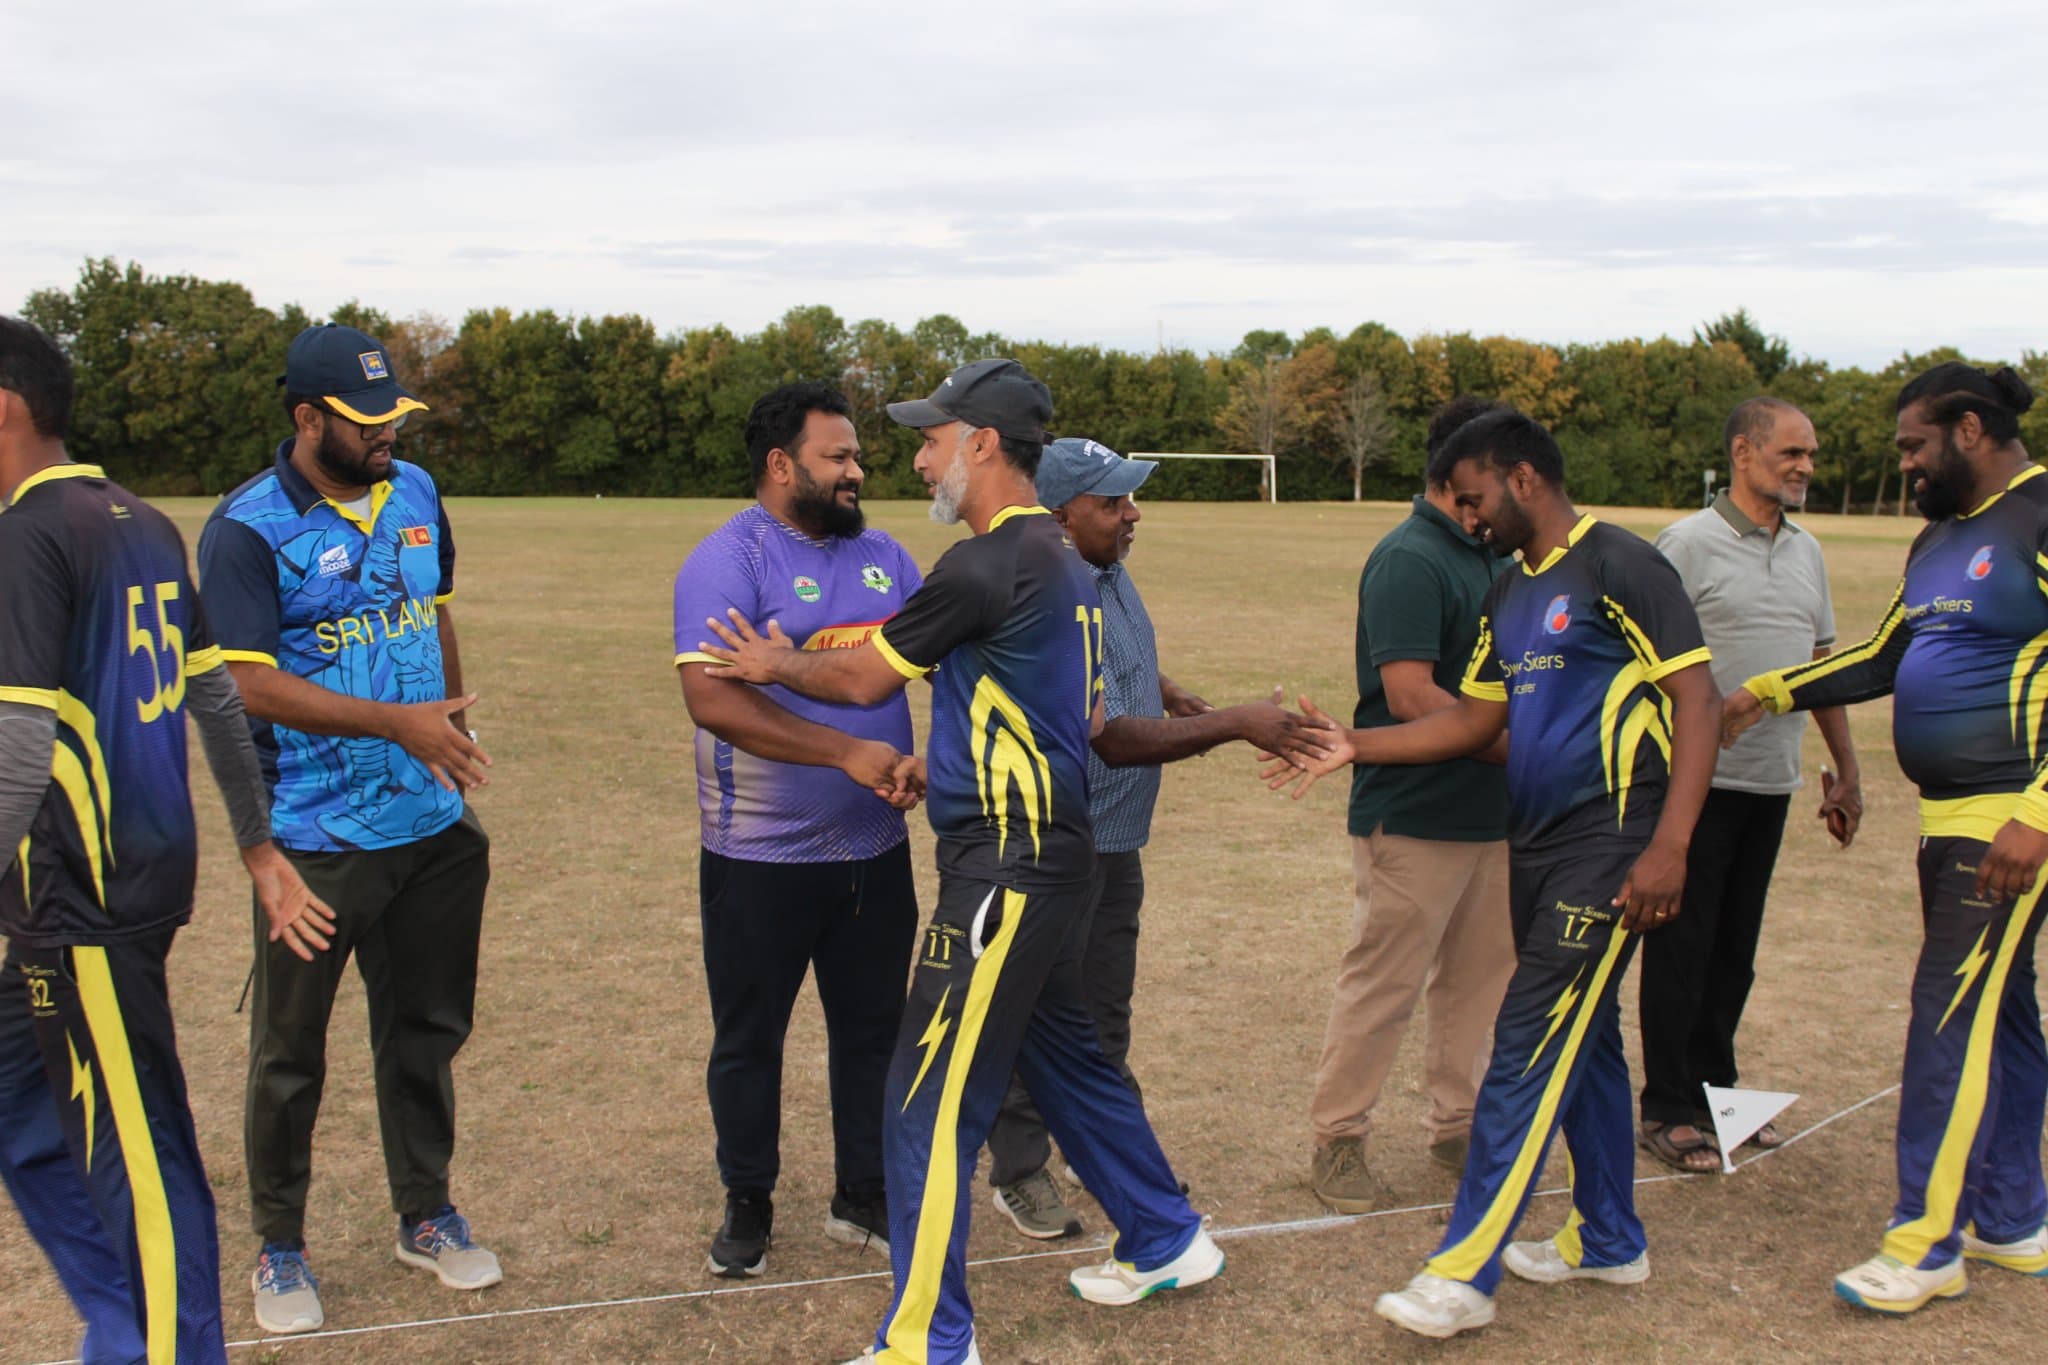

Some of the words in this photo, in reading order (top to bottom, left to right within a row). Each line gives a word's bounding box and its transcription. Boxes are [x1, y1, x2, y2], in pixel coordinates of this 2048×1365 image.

[315, 613, 375, 655] SRI
[379, 595, 436, 639] LANK
[127, 581, 186, 723] 55
[929, 932, 950, 961] 11
[1564, 914, 1594, 941] 17
